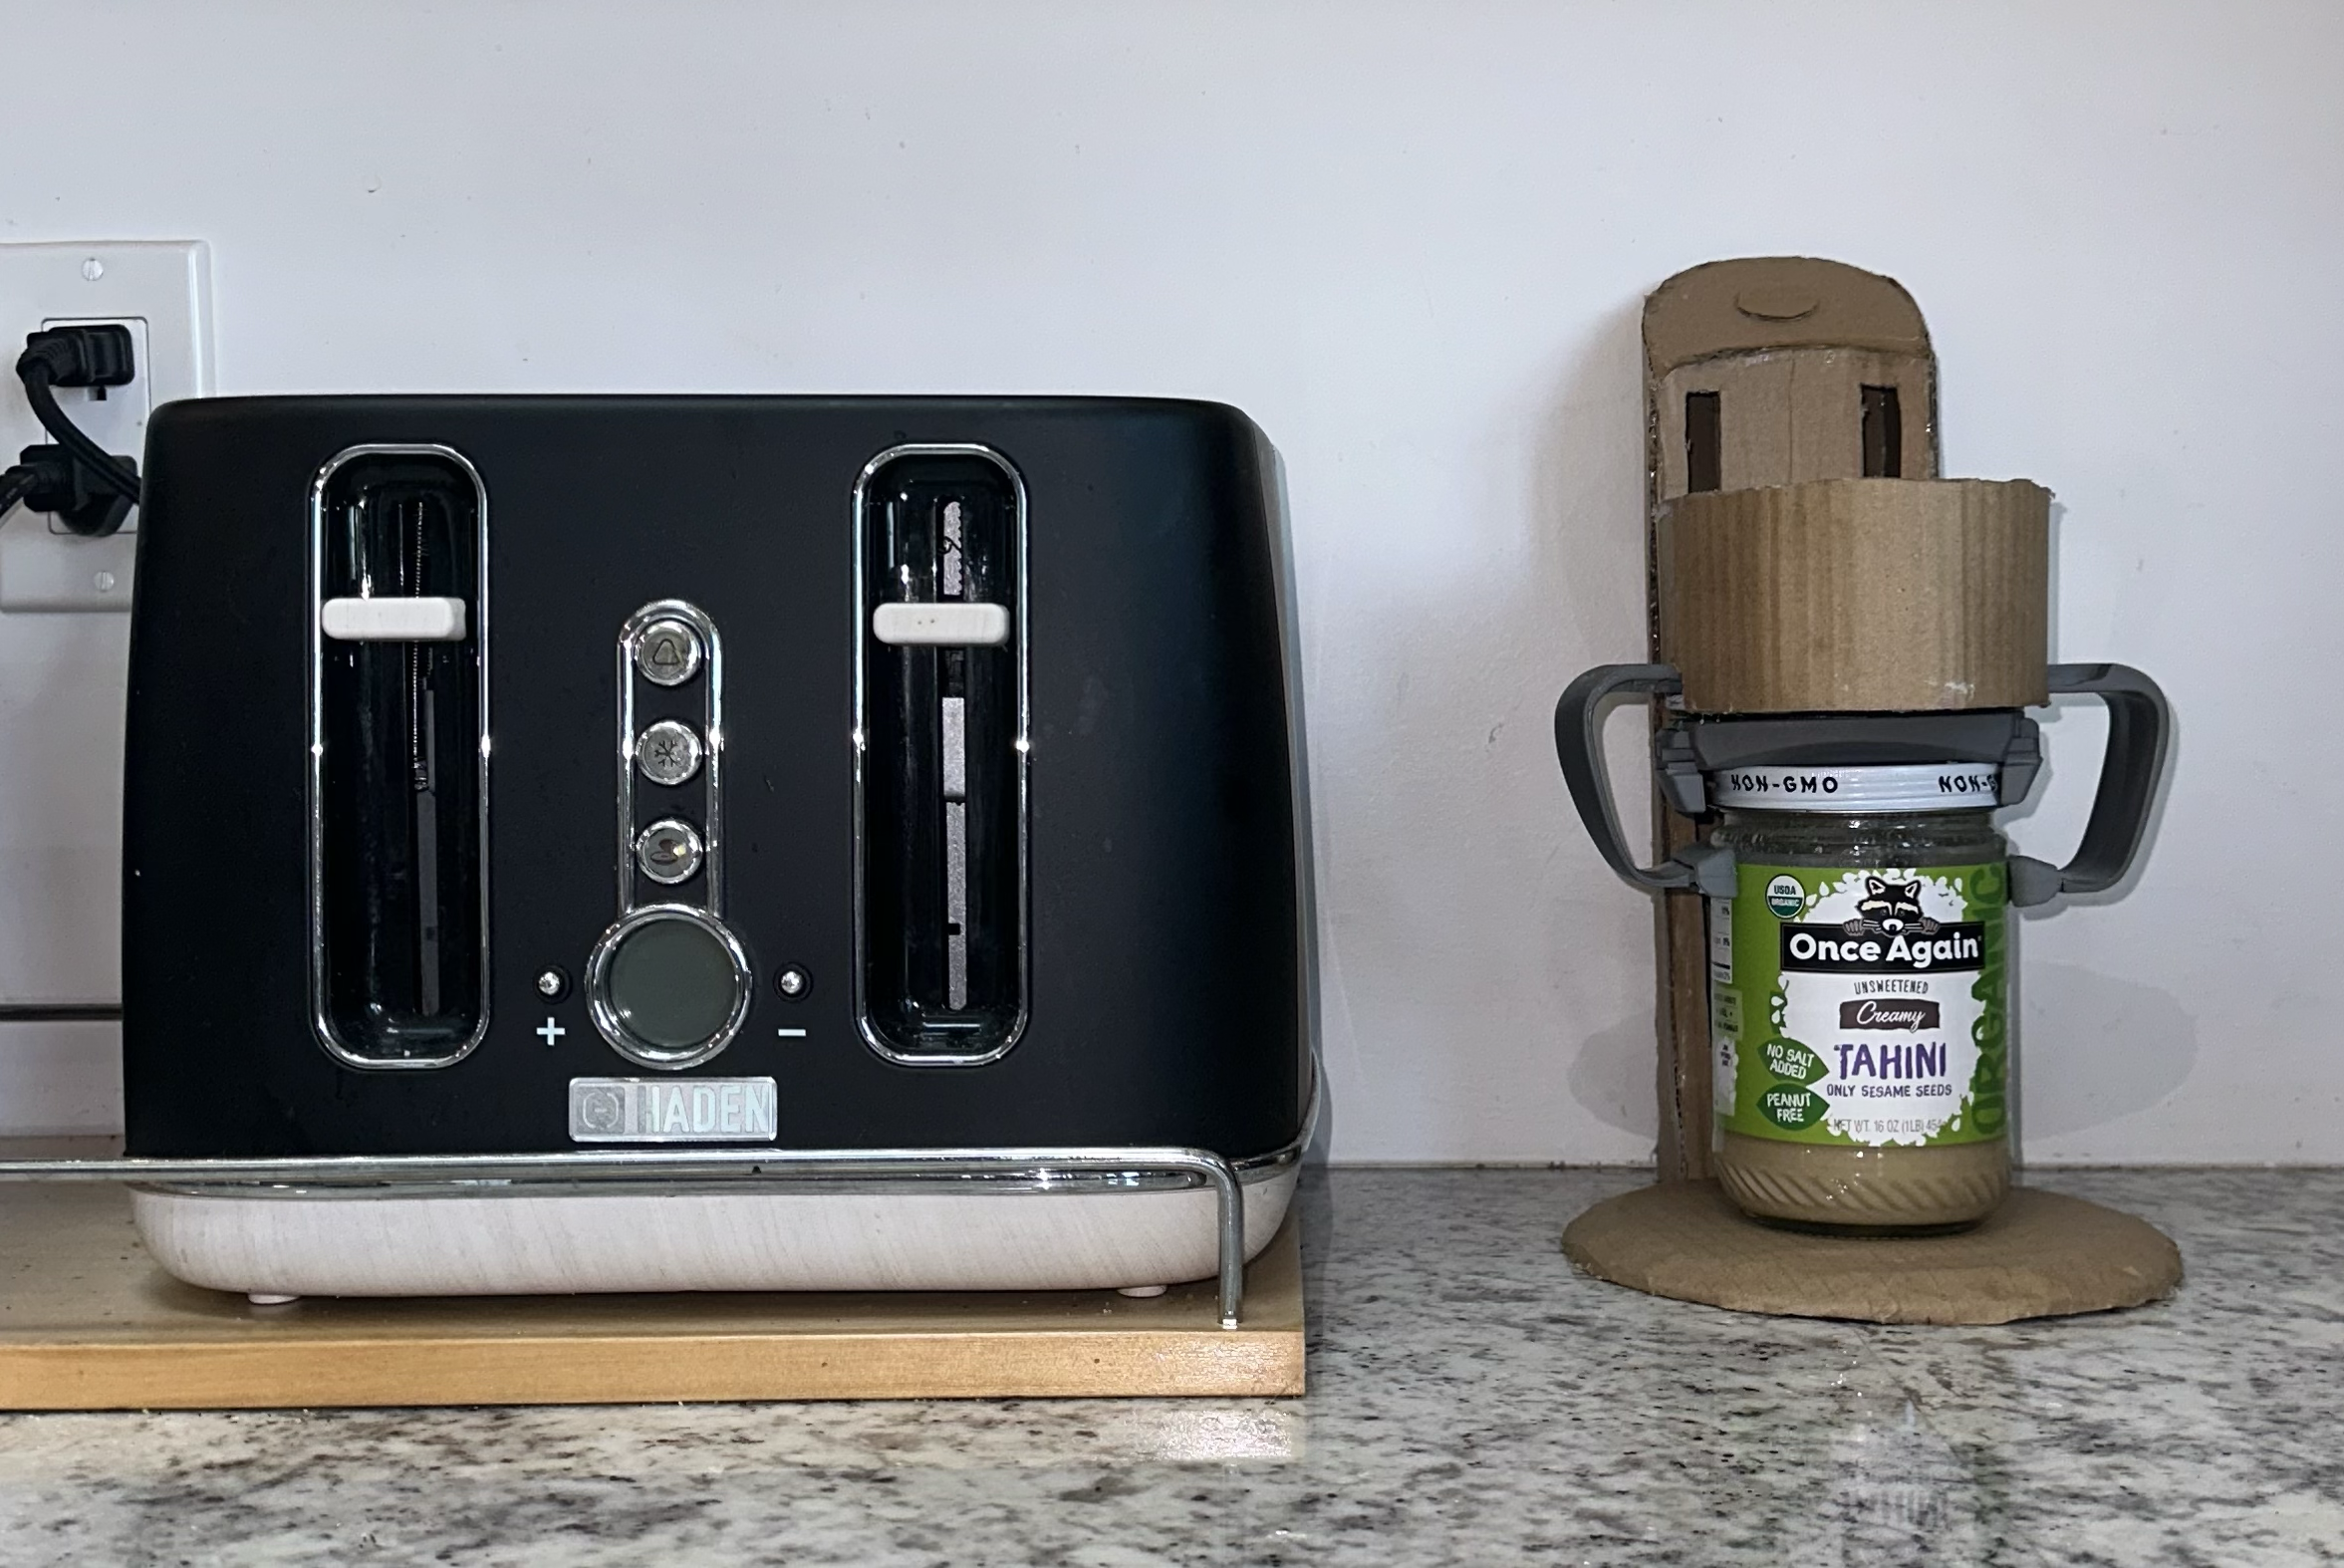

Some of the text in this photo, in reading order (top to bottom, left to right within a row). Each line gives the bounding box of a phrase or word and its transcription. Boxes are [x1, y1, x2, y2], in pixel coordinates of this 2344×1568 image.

[1730, 773, 1838, 794] NON-GMO
[1773, 885, 1797, 896] USDA
[1789, 931, 1979, 968] Once Again
[1853, 978, 1930, 995] UNSWEETENED
[1856, 1000, 1927, 1034] Creamy
[1766, 1043, 1815, 1068] NO SALT
[1833, 1041, 1948, 1081] TAHINI
[1769, 1058, 1807, 1080] ADDED
[1766, 1092, 1811, 1108] PEANUT
[1826, 1083, 1953, 1098] ONLY SESAME SEEDS
[638, 1084, 770, 1133] HADEN
[1776, 1108, 1804, 1123] FREE
[1874, 1119, 1884, 1133] 16
[1886, 1119, 1900, 1133] OZ
